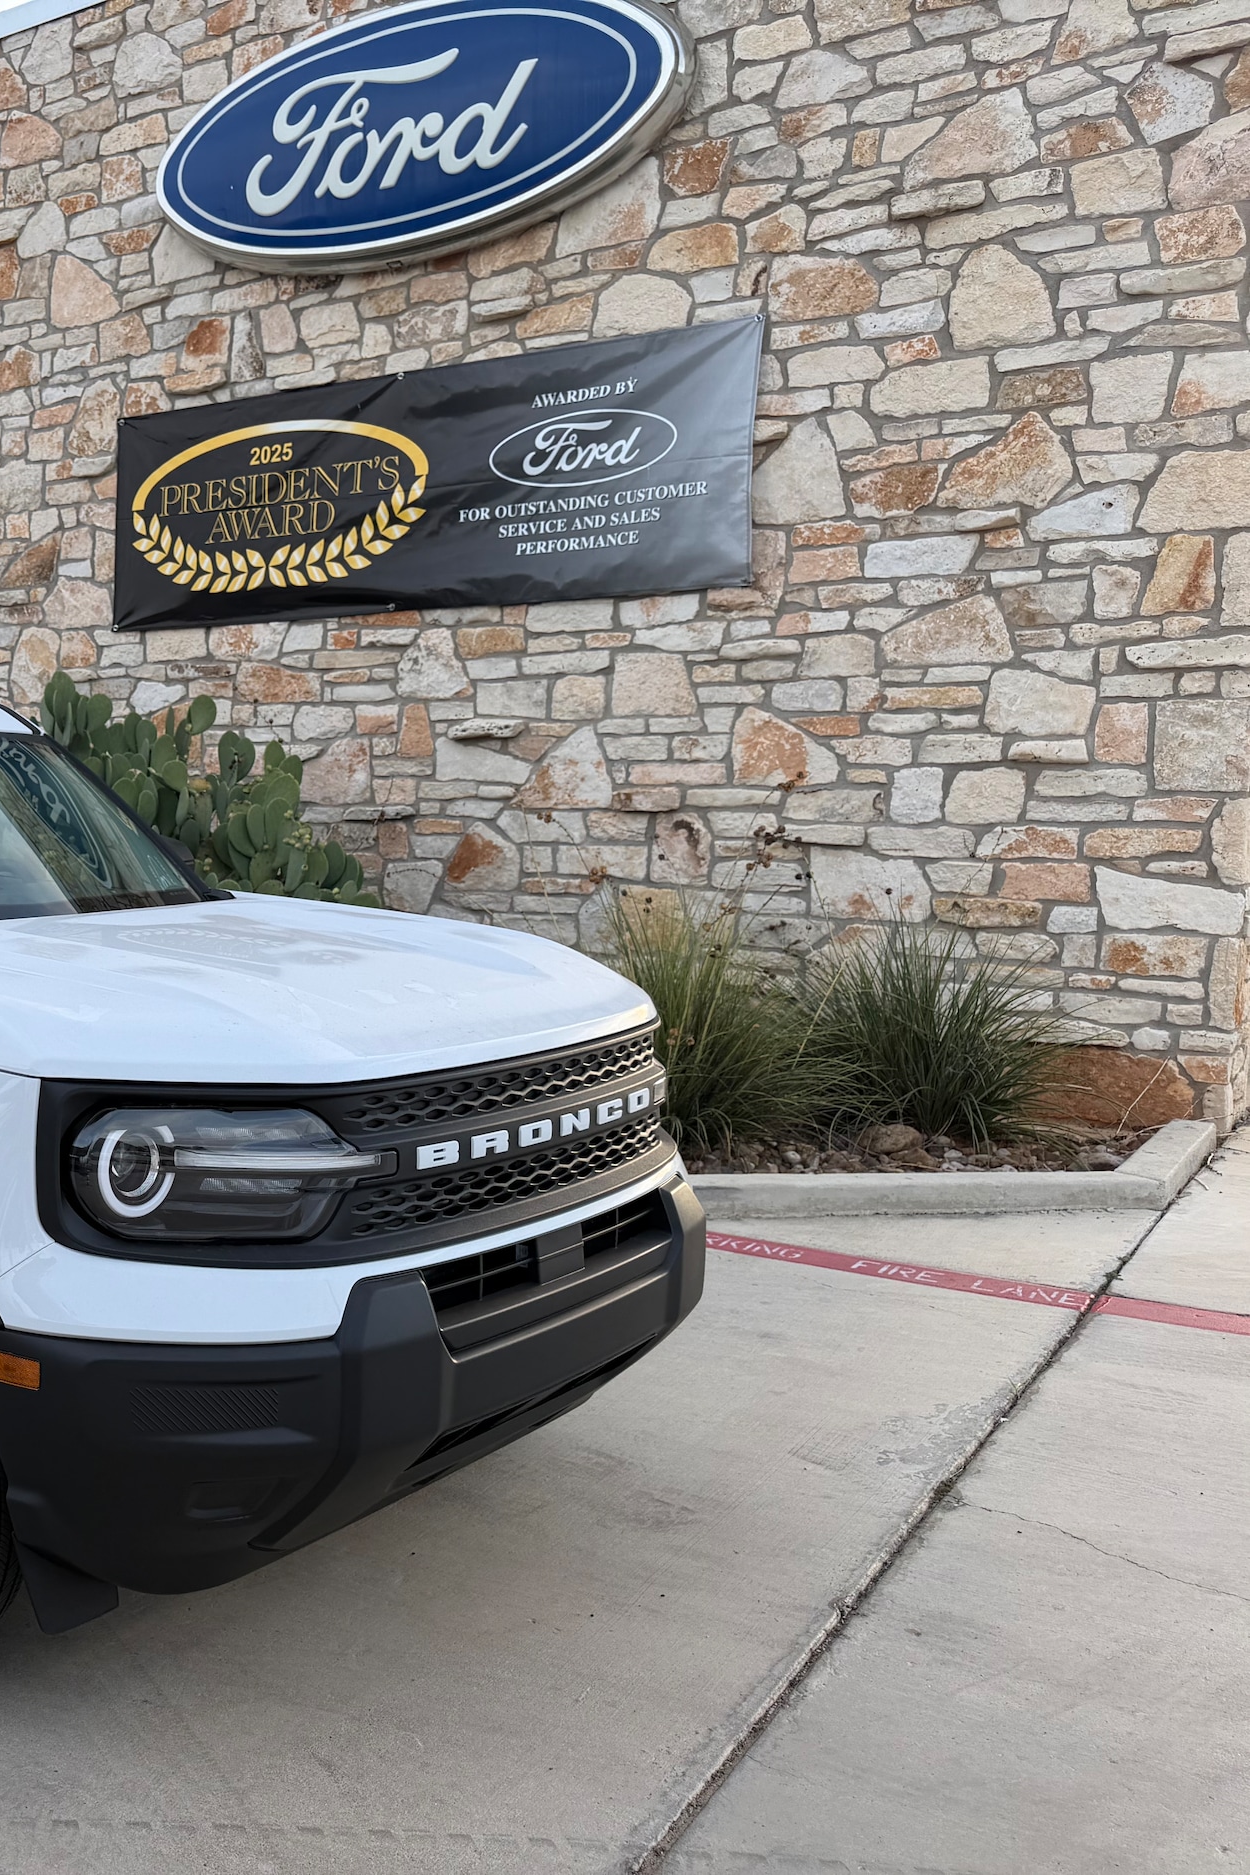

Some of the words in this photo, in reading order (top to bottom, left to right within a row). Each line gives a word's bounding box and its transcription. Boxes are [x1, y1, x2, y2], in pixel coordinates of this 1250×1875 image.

[246, 47, 538, 217] Ford
[531, 384, 611, 409] AWARDED
[614, 379, 638, 394] BY
[250, 442, 293, 466] 2025
[522, 419, 642, 476] Ford
[159, 456, 400, 517] PRESIDENT'S
[459, 507, 491, 522] FOR
[495, 493, 609, 519] OUTSTANDING
[614, 481, 708, 506] CUSTOMER
[205, 500, 335, 544] AWARD
[498, 519, 567, 539] SERVICE
[571, 514, 606, 531] AND
[610, 507, 661, 527] SALES
[515, 530, 639, 556] PERFORMANCE
[416, 1087, 651, 1170] BRONCO
[851, 1259, 945, 1283] FIRE
[971, 1279, 1086, 1307] LANE
